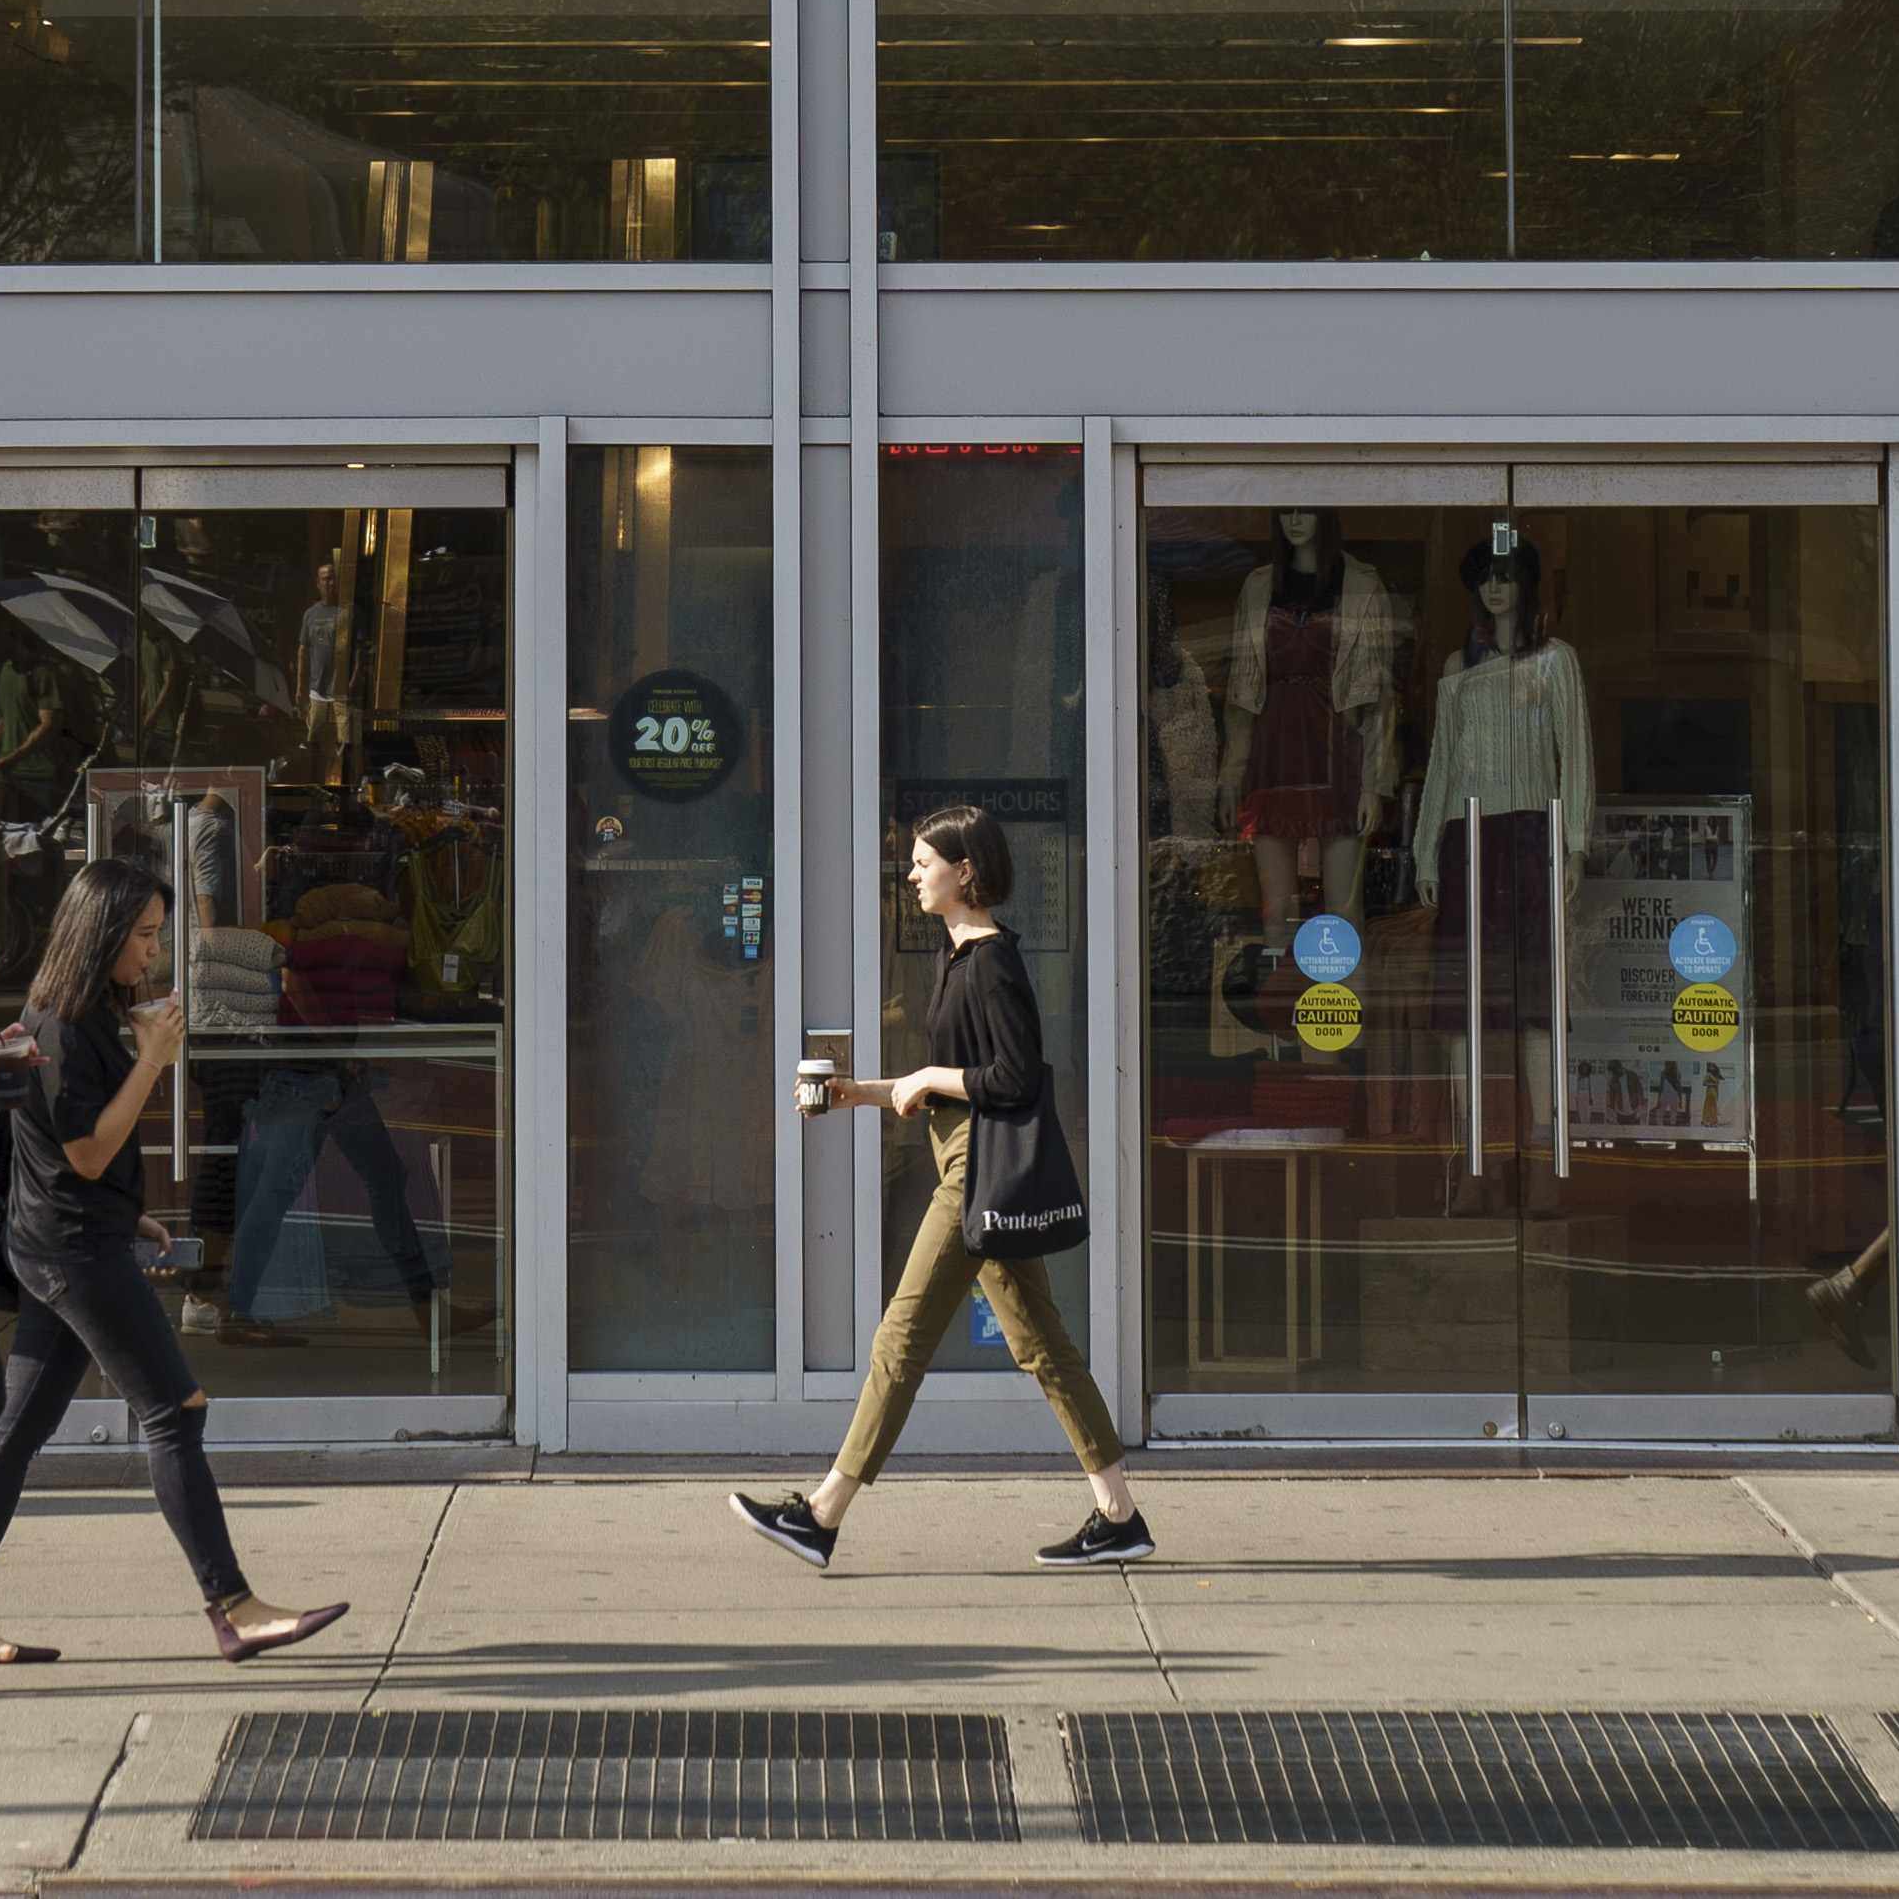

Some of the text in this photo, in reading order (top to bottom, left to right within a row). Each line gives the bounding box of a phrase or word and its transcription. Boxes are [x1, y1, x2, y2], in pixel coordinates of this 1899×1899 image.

[981, 790, 1062, 812] HOURS
[1622, 898, 1672, 916] WE'RE
[1621, 968, 1676, 983] DISCOVER
[1301, 997, 1357, 1007] AUTOMATIC
[1621, 990, 1660, 1002] FOREVER
[1678, 998, 1734, 1007] AUTOMATIC
[1298, 1011, 1358, 1023] CAUTION
[1674, 1011, 1735, 1023] CAUTION
[1315, 1027, 1342, 1036] DOOR
[1692, 1028, 1719, 1037] DOOR
[981, 1204, 1082, 1231] Pentagram
